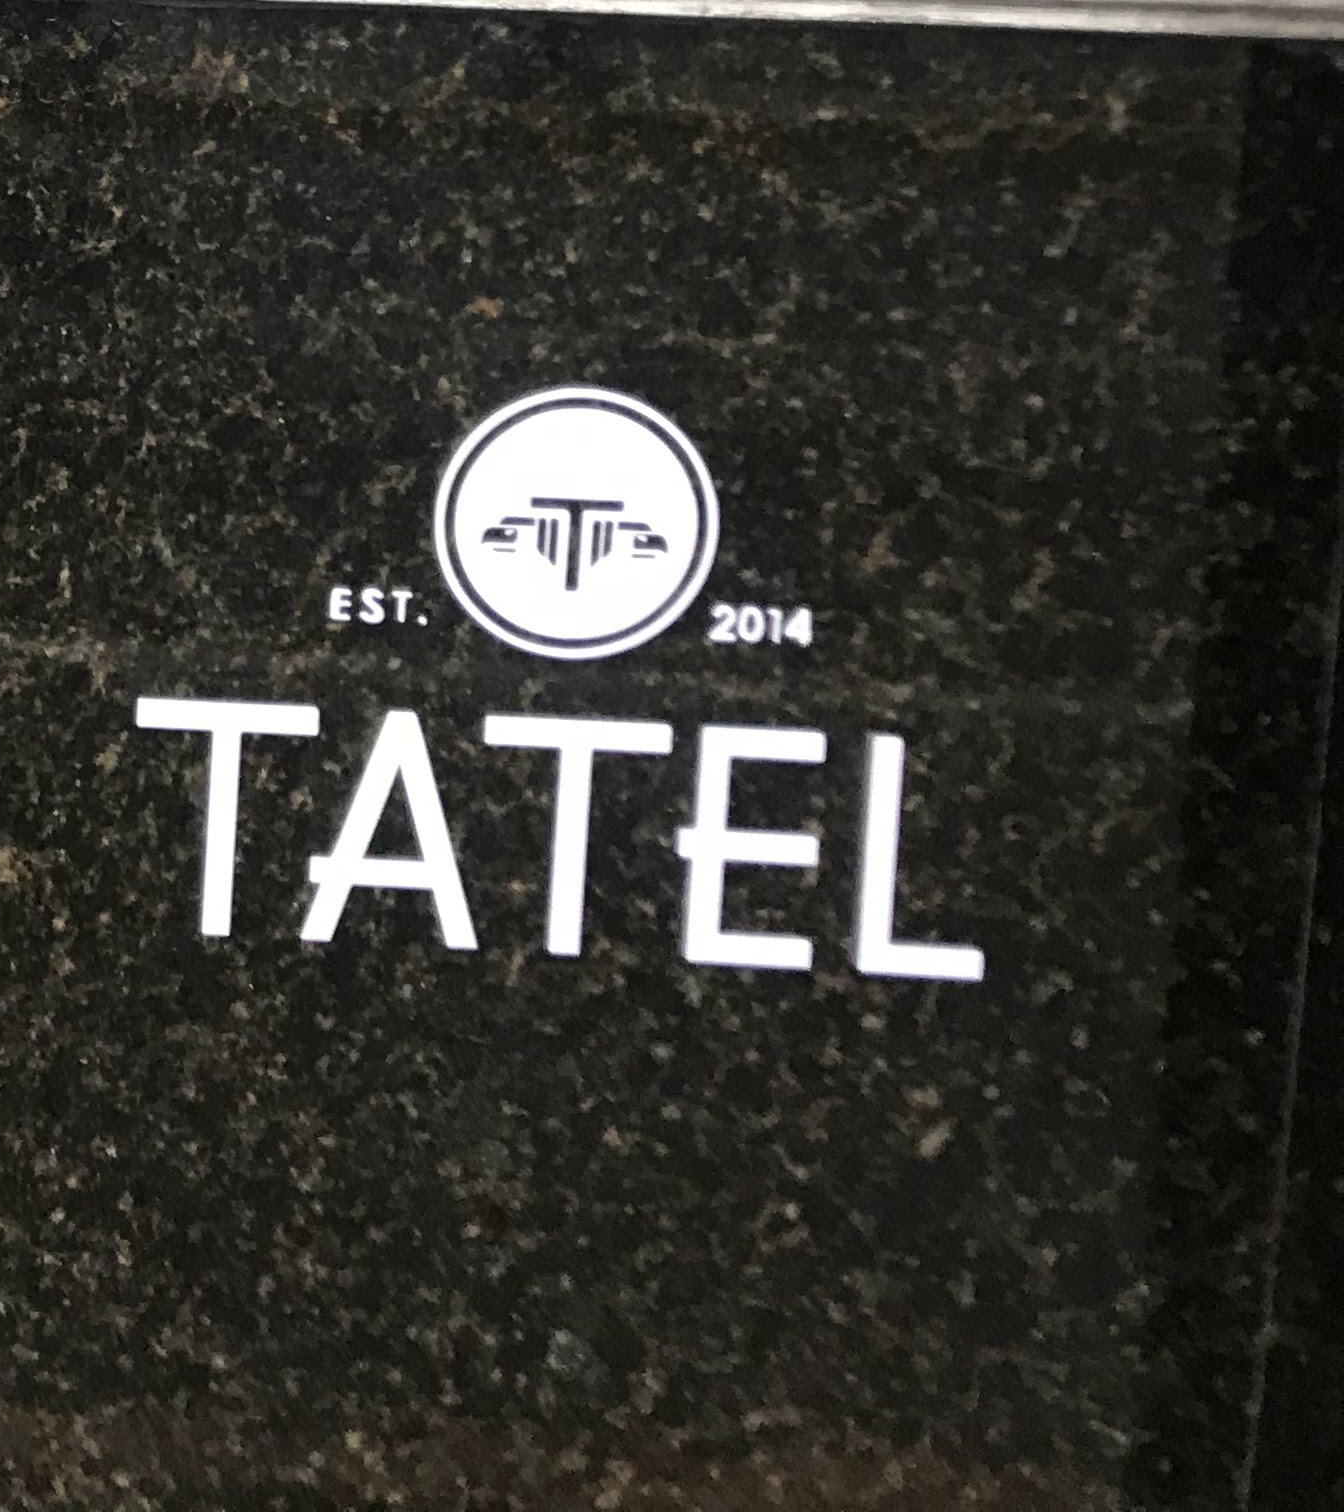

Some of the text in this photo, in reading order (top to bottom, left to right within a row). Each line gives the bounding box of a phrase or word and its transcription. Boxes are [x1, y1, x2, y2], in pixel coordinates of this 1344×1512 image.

[328, 587, 429, 626] EST.
[708, 603, 814, 647] 2014
[136, 696, 984, 982] TATEL
